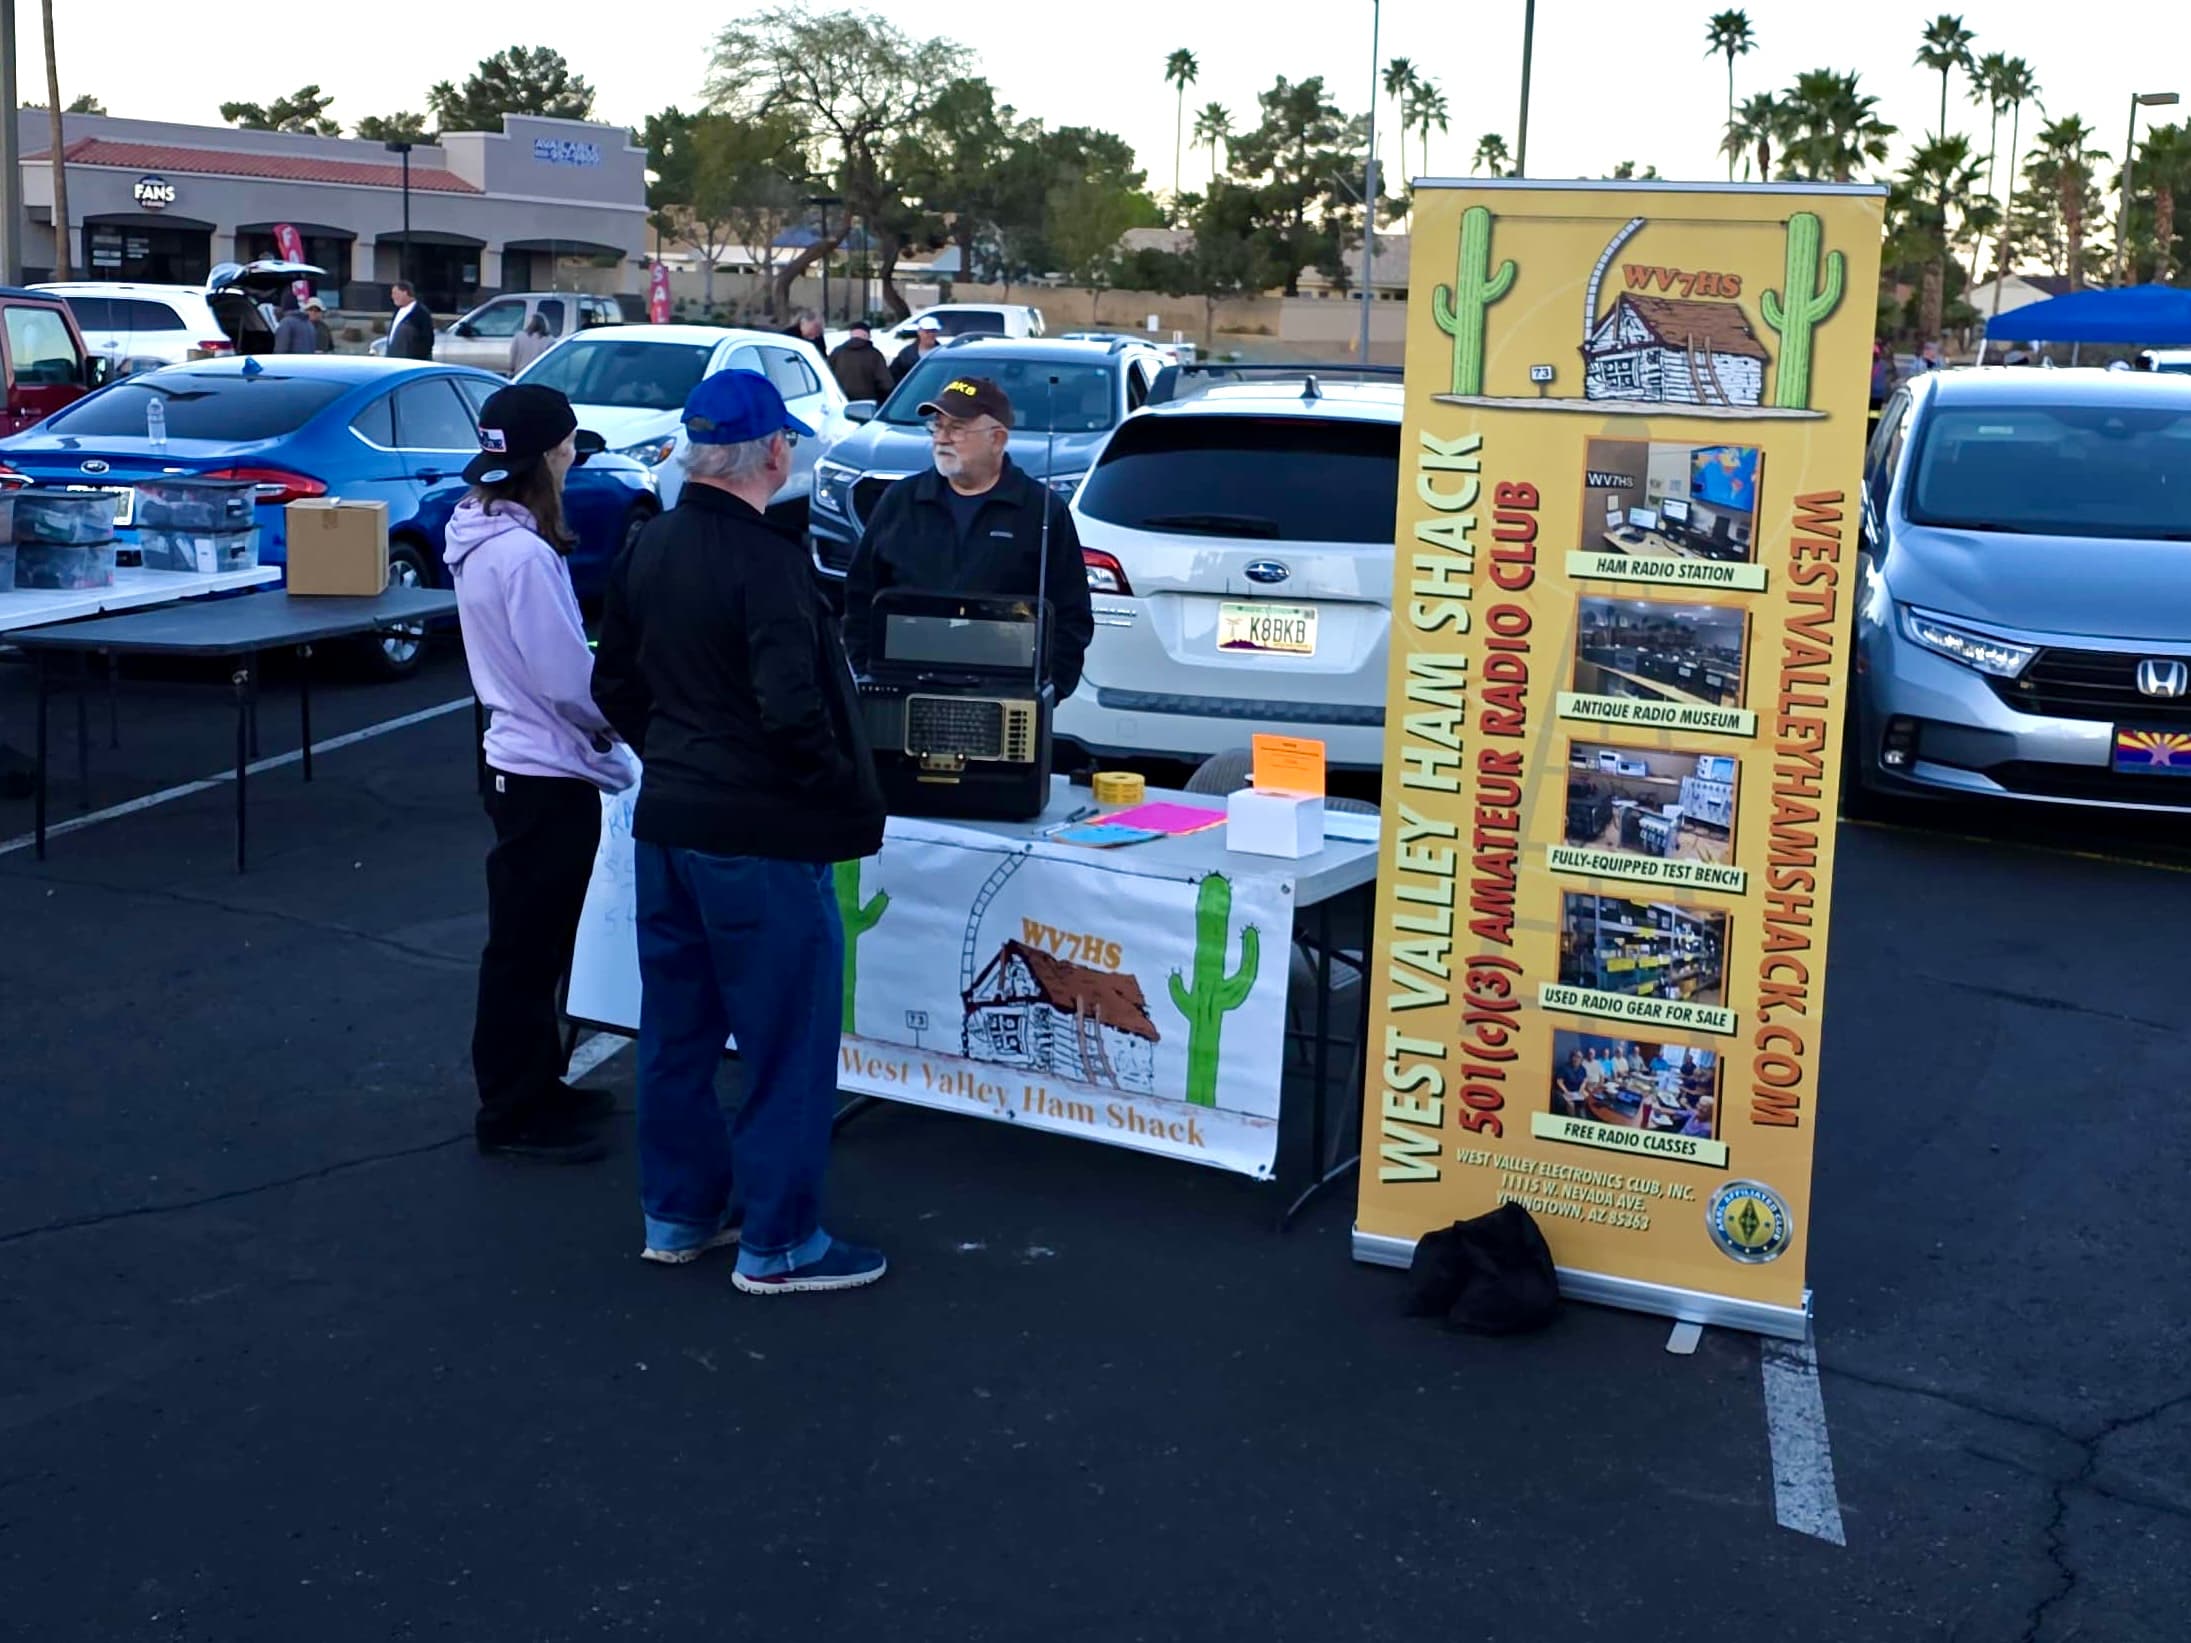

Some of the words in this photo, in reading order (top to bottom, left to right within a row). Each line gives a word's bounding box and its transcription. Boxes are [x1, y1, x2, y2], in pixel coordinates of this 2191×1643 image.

[134, 183, 176, 202] FANS
[1623, 264, 1743, 298] WV7HS
[1533, 367, 1551, 379] 73
[1587, 471, 1635, 488] WV7HS
[1408, 429, 1483, 634] SHACK
[1488, 481, 1540, 592] CLUB
[1596, 557, 1627, 575] HAM
[1630, 560, 1675, 578] RADIO
[1677, 564, 1735, 582] STATION
[1249, 616, 1307, 644] K8BKB
[1480, 603, 1533, 738] RADIO
[1400, 652, 1469, 794] HAM
[1572, 699, 1630, 719] ANTIQUE
[1632, 705, 1677, 723] RADIO
[1679, 709, 1741, 729] MUSEUM
[1750, 490, 1845, 1128] WESTVALLEYHAMSHACK.COM
[1468, 748, 1524, 947] AMATEUR
[1551, 849, 1659, 876] FULLY-EQUIPPED
[1662, 863, 1693, 880] TEST
[1694, 867, 1740, 886] BENCH
[1386, 802, 1459, 1012] VALLEY
[1022, 917, 1123, 970] WV7HS
[1544, 987, 1578, 1006] USED
[1581, 993, 1623, 1013] RADIO
[1626, 1000, 1663, 1019] GEAR
[1665, 1005, 1693, 1023] FOR
[1695, 1009, 1728, 1028] SALE
[1458, 954, 1524, 1139] 501(c)(3)
[841, 1046, 909, 1085] West
[921, 1061, 1009, 1115] Valley
[1023, 1085, 1096, 1125] Ham
[1106, 1101, 1206, 1148] Shack
[1378, 1024, 1447, 1184] WEST
[1564, 1121, 1593, 1140] FREE
[1597, 1127, 1640, 1147] RADIO
[1643, 1134, 1698, 1156] CLASSES
[1456, 1148, 1493, 1166] WEST
[1493, 1154, 1539, 1175] VALLEY
[1538, 1162, 1623, 1189] ELECTRONICS
[1626, 1174, 1664, 1198] CLUB,
[1667, 1183, 1697, 1202] INC.
[1502, 1173, 1540, 1194] 11115
[1542, 1180, 1559, 1197] W.
[1561, 1184, 1615, 1207] NEVADA
[1616, 1194, 1648, 1212] AVE.
[1588, 1208, 1606, 1223] AZ
